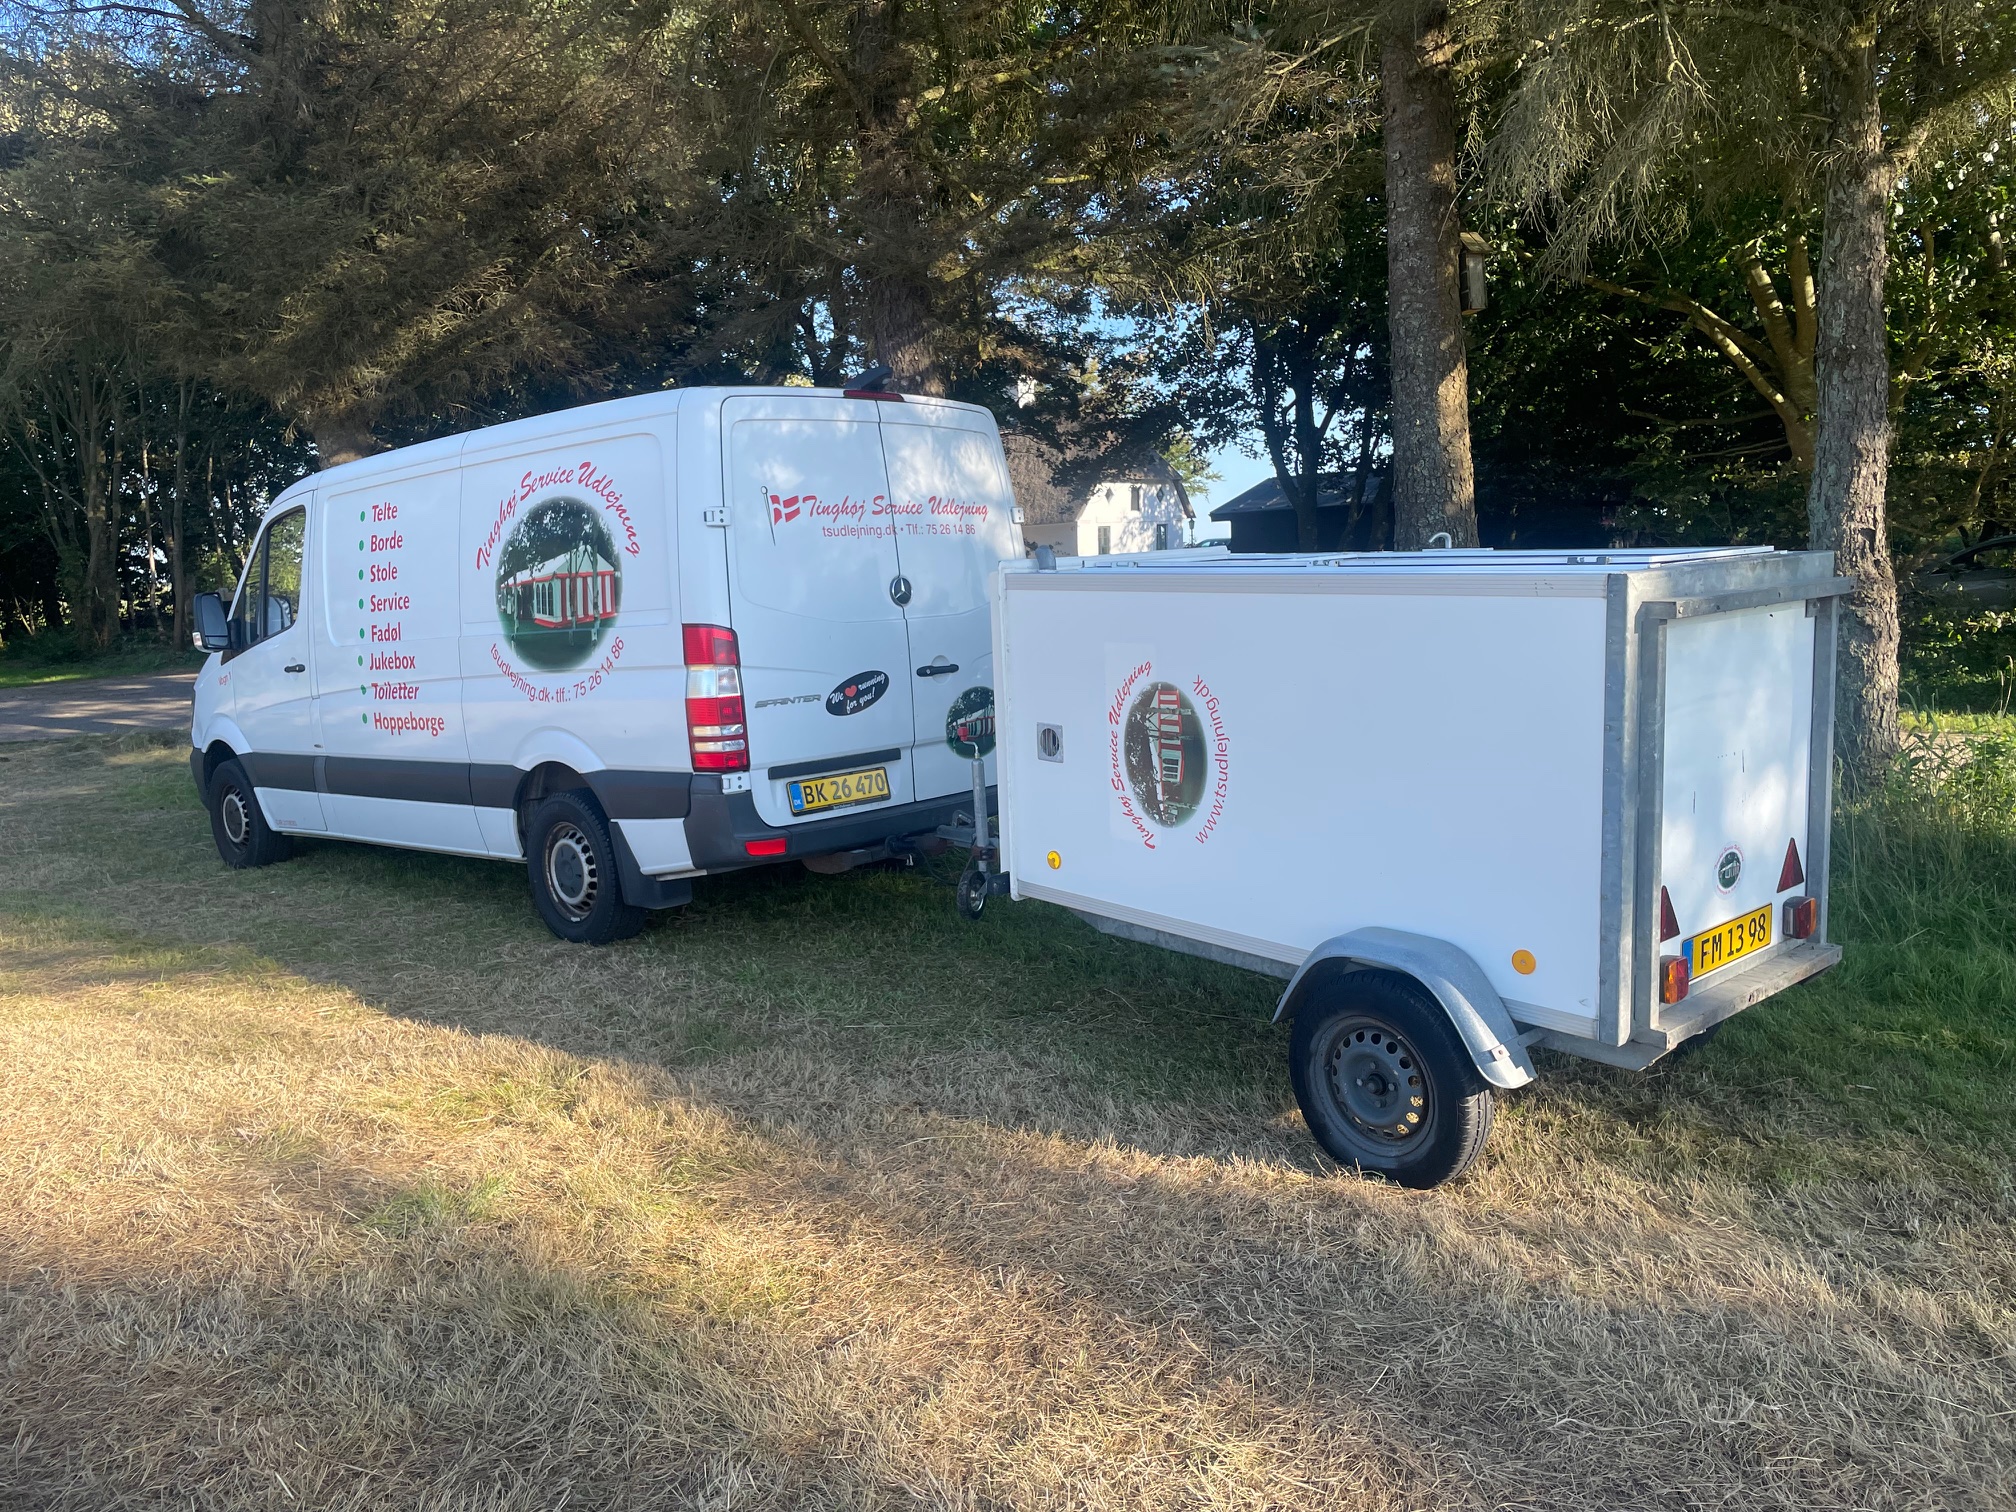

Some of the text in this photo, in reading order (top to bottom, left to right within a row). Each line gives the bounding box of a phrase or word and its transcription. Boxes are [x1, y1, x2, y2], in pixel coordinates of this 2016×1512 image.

[371, 501, 398, 523] Telte
[476, 461, 641, 571] Tinghøj Service Udlejning
[801, 495, 989, 524] Tinghøj Service Udlejning
[370, 530, 403, 553] Borde
[822, 523, 976, 539] tsudlejning.dk Tlf.: 75 26 14 86
[370, 561, 398, 583] Stole
[370, 592, 410, 613] Service
[371, 622, 401, 643] Fadøl
[369, 650, 416, 671] Jukebox
[490, 643, 551, 703] tsudlejning.dk
[573, 680, 587, 698] 75
[588, 670, 602, 691] 26
[600, 656, 614, 676] 14
[611, 636, 625, 660] 86
[371, 681, 420, 700] Toiletter
[754, 693, 822, 709] SPRINTER
[829, 673, 886, 704] We running
[846, 686, 876, 714] for you!
[373, 711, 445, 737] Hoppeborge
[1108, 660, 1156, 850] Tinghøj Service Udlejning
[1192, 674, 1231, 844] www.tsudlejning.dk
[802, 772, 886, 805] BK 26 470
[1700, 913, 1766, 970] FM 13 98
